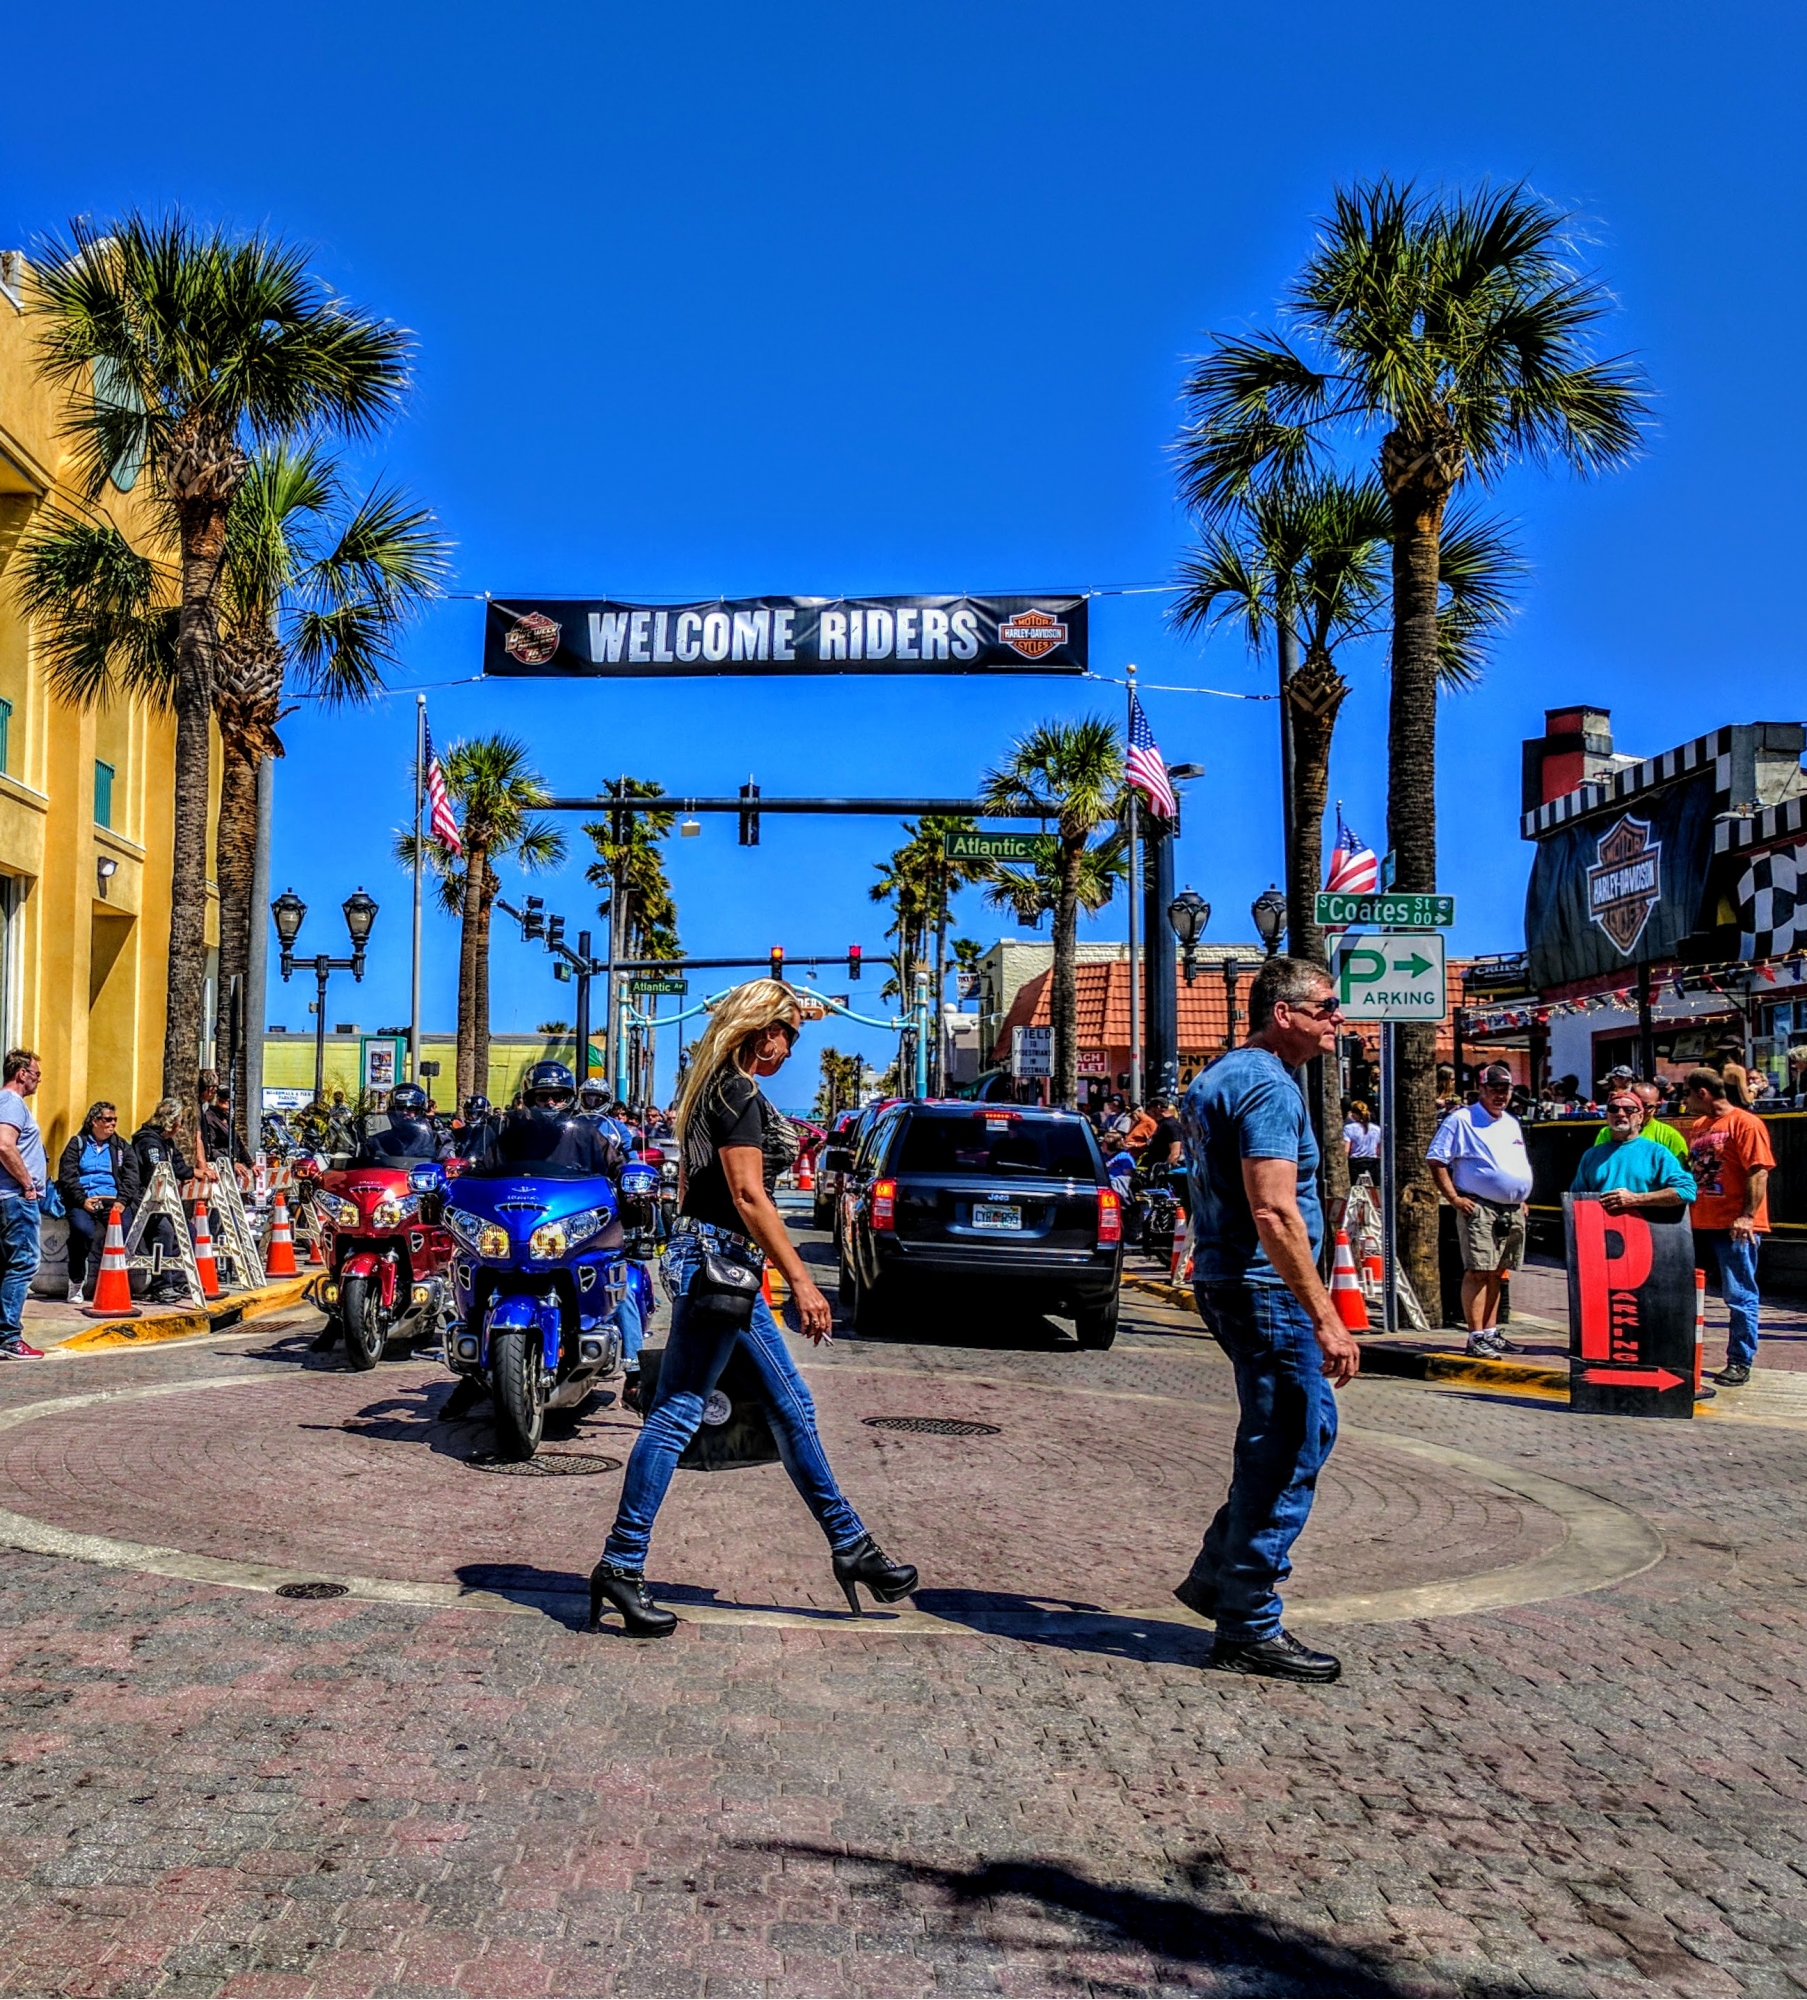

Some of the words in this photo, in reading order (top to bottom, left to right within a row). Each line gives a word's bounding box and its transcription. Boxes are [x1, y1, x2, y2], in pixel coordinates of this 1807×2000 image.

[1018, 615, 1049, 626] MOTOR
[587, 609, 796, 663] WELCOME
[818, 608, 979, 661] RIDERS
[1004, 628, 1062, 639] HARLEY-DAVIDSON
[1018, 641, 1049, 654] CYCLES
[953, 837, 1027, 856] Atlantic
[1593, 858, 1655, 905] HARLEY-DAVIDSON
[1319, 895, 1328, 908] S
[1328, 896, 1408, 922] Coates
[1414, 897, 1430, 910] St
[1413, 912, 1432, 924] 00
[1474, 962, 1523, 974] CRUIS
[633, 981, 671, 992] Atlantic
[674, 982, 684, 990] Av
[1015, 1029, 1052, 1039] YIELD
[1029, 1040, 1037, 1048] TO
[1076, 1053, 1100, 1062] ACH
[1178, 1055, 1211, 1066] ENT
[1076, 1062, 1104, 1072] TLET
[987, 1193, 1010, 1202] Jeep
